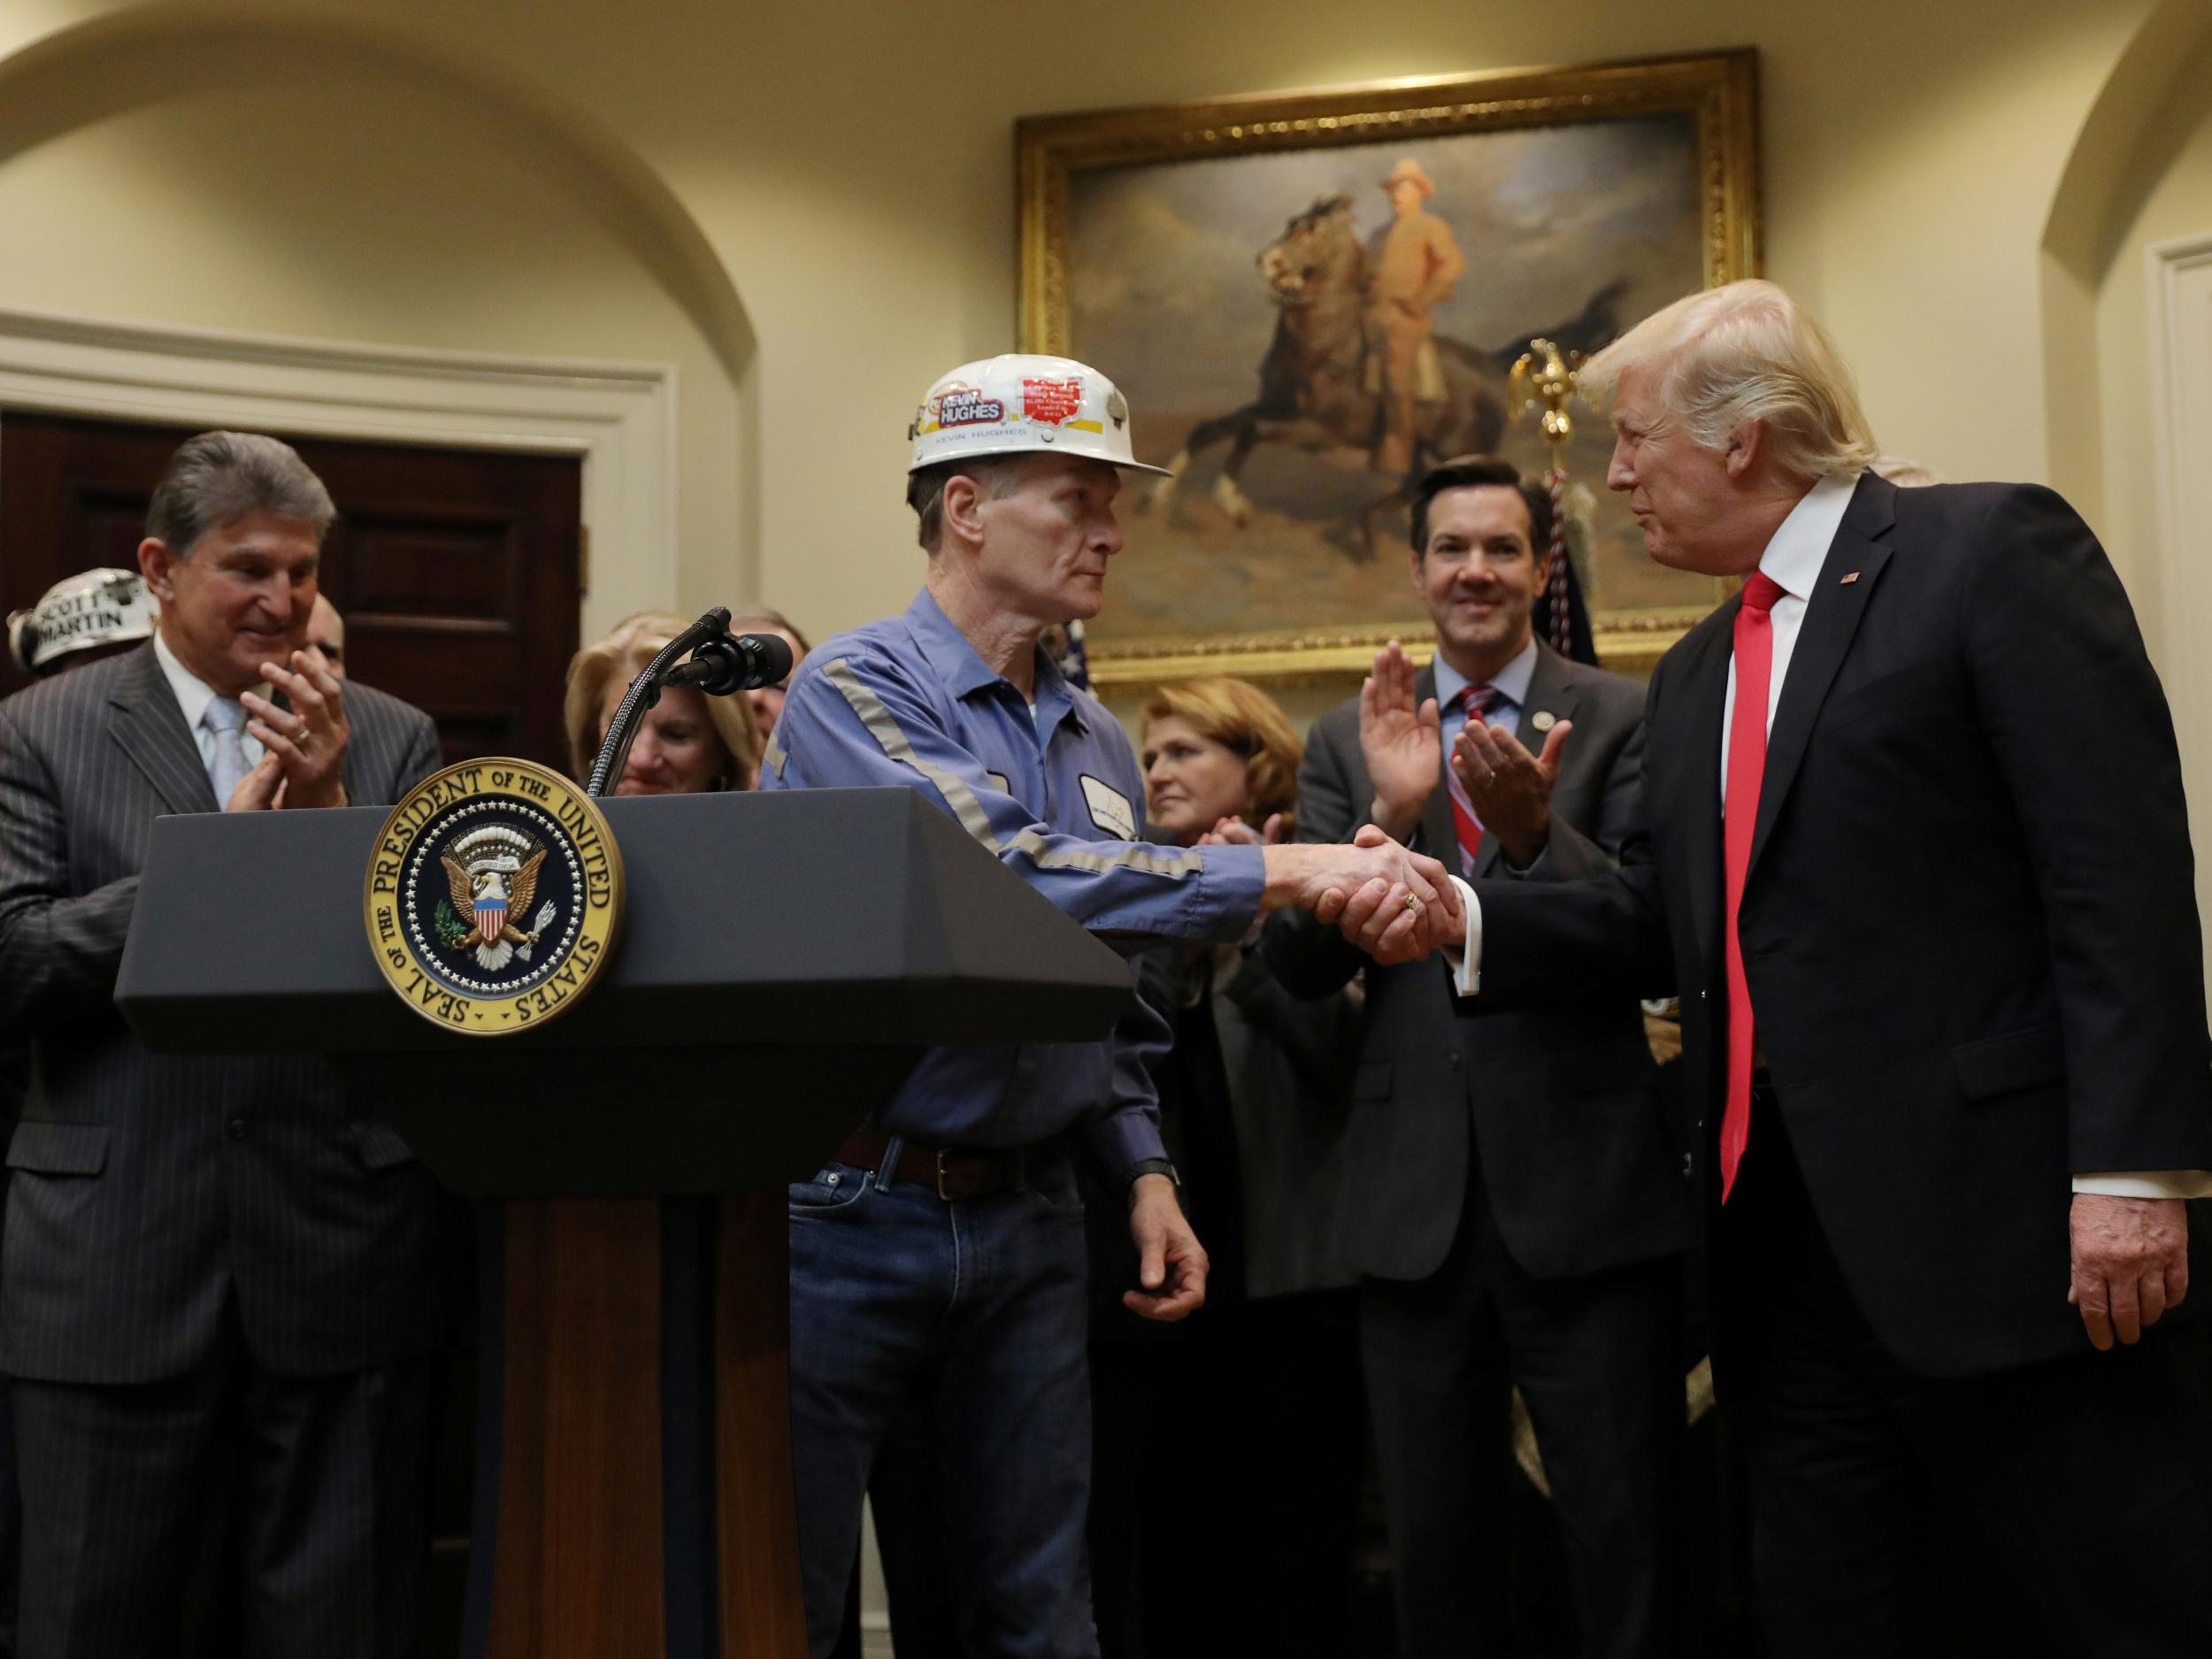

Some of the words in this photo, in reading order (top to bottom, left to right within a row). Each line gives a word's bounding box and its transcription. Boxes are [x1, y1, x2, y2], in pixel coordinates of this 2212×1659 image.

[941, 403, 1000, 425] HUGHES
[942, 392, 978, 408] KEVIN
[935, 433, 967, 444] KEVIN
[972, 427, 1027, 437] HUGHES
[38, 611, 122, 645] MARTIN
[491, 771, 514, 787] OF
[519, 775, 551, 802] THE
[373, 766, 483, 895] PRESIDENT
[558, 795, 611, 909] UNITED
[377, 905, 396, 942] THE
[387, 947, 406, 969] OF
[515, 934, 600, 1021] STATES
[406, 967, 470, 1023] SEAL
